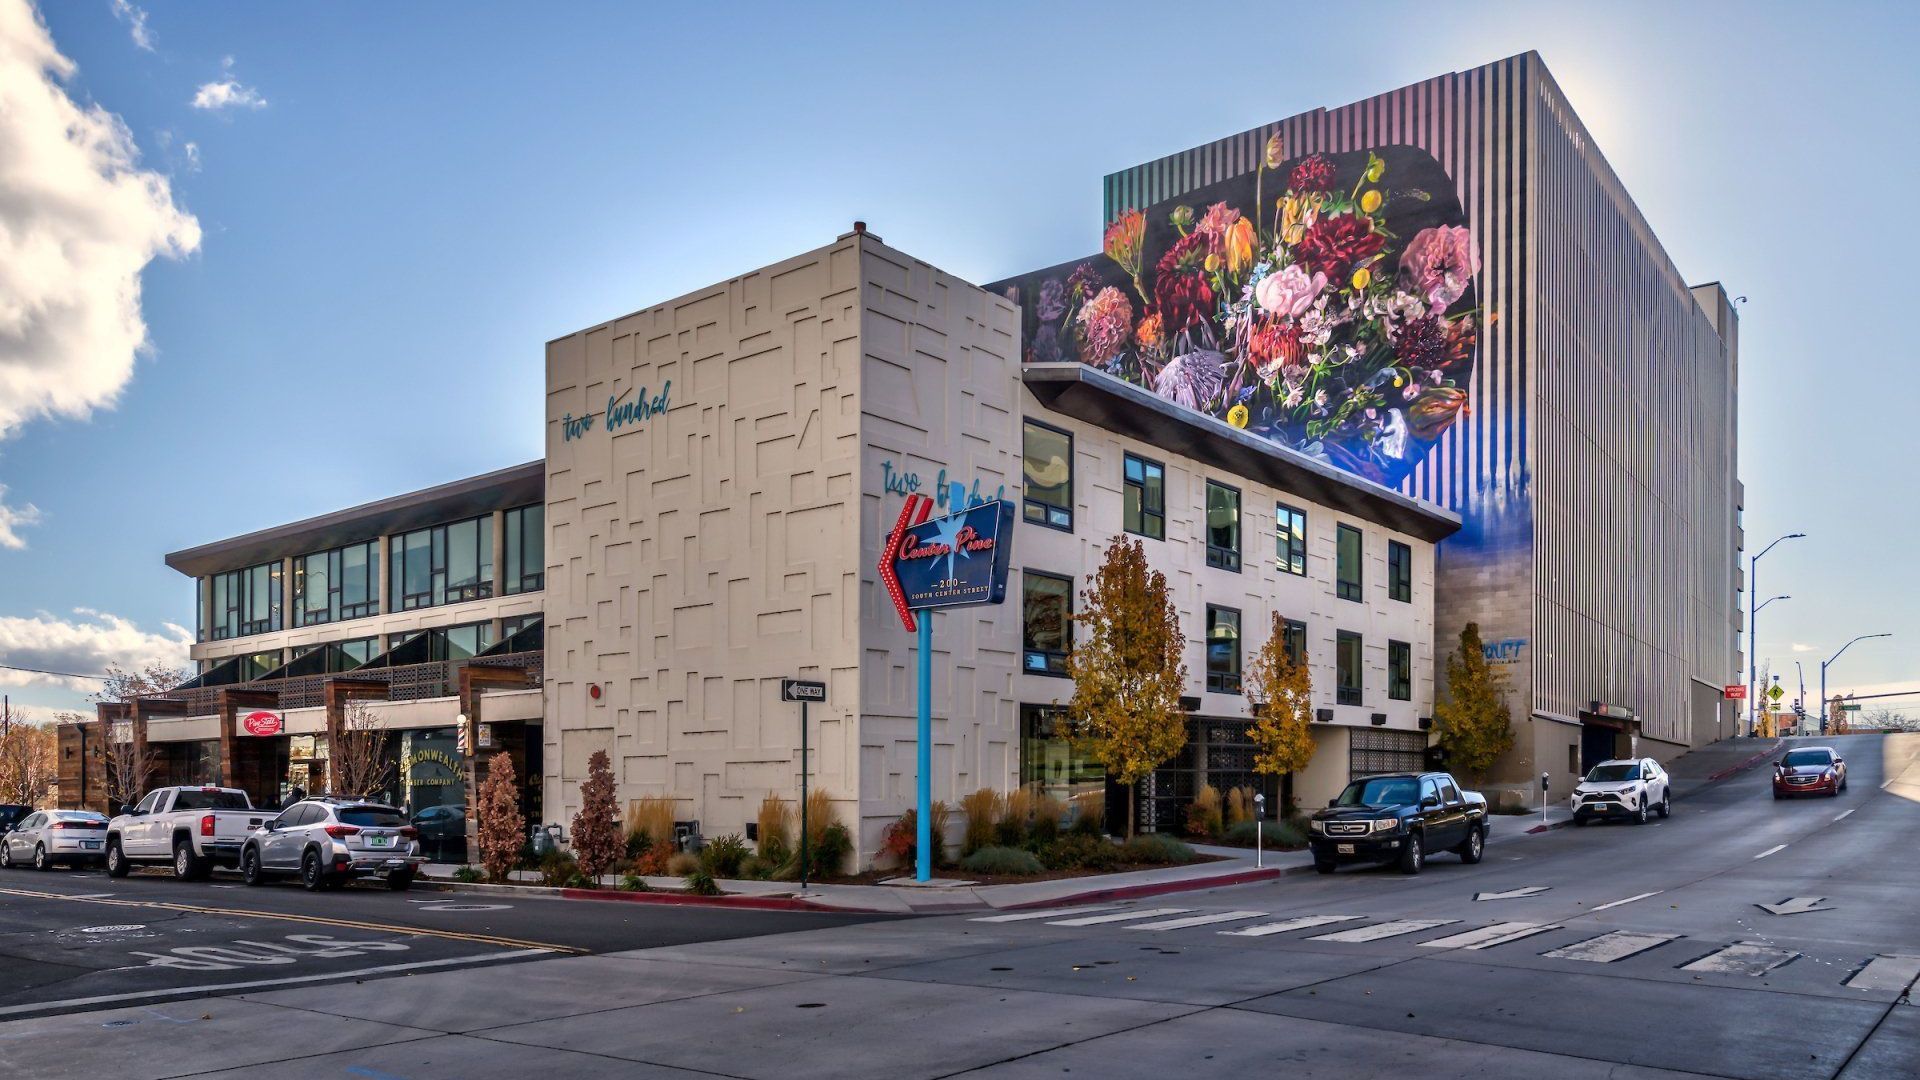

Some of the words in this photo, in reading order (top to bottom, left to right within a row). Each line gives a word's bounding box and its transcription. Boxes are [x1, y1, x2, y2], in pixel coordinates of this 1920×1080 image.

[563, 413, 594, 441] two
[606, 380, 671, 432] hundred
[880, 460, 922, 498] two
[899, 534, 950, 561] Center
[955, 526, 993, 553] Pine
[911, 592, 933, 600] SOUTH
[935, 589, 961, 598] CENTER
[963, 586, 989, 594] STREET
[797, 686, 809, 695] ONE
[810, 687, 821, 695] WAY
